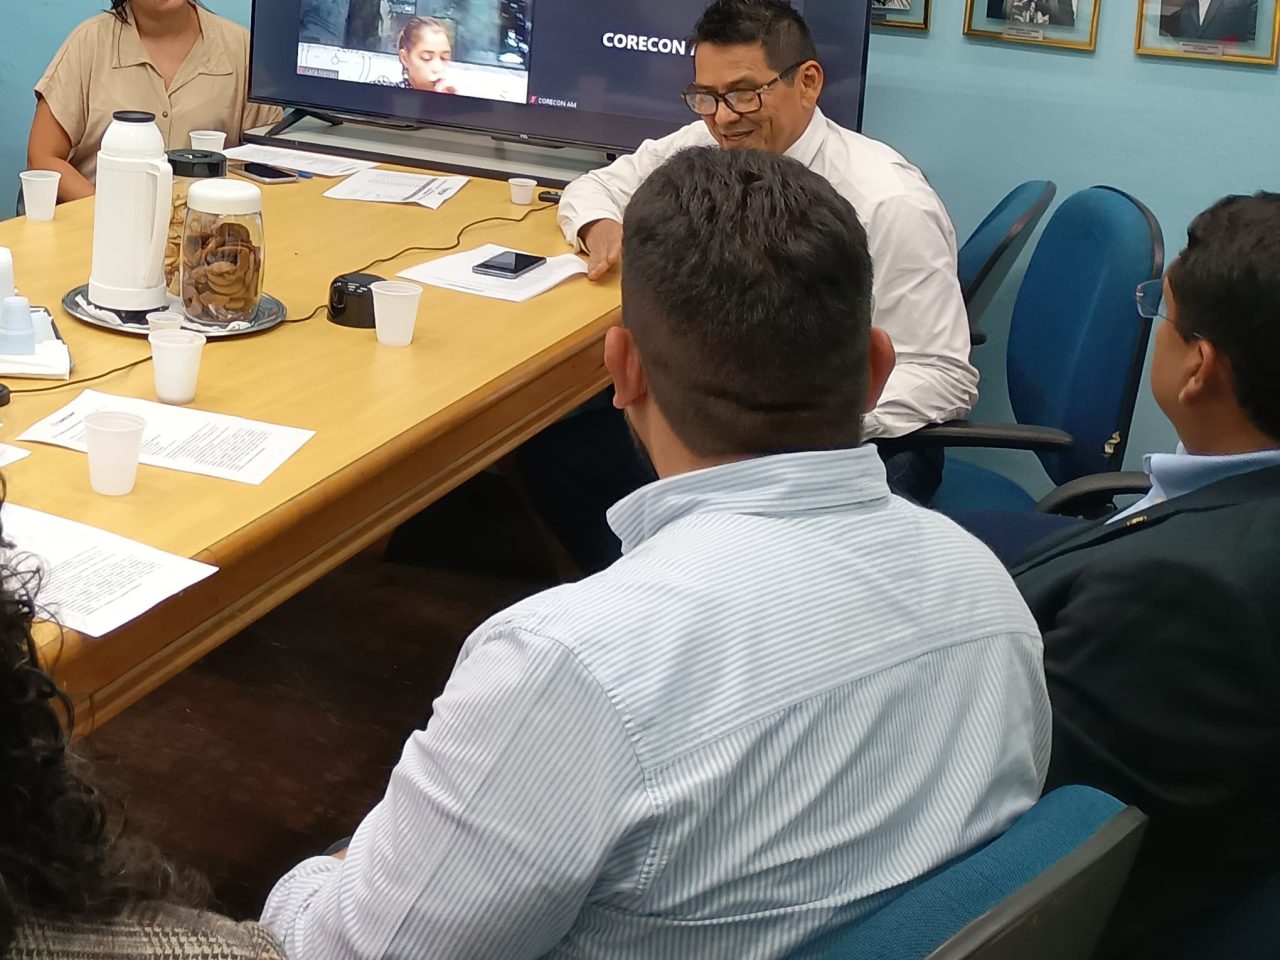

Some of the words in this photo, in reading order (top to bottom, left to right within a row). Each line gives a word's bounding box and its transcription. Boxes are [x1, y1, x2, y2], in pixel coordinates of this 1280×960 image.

[602, 32, 686, 56] CORECON
[538, 97, 566, 107] CORECON
[566, 101, 577, 109] AM
